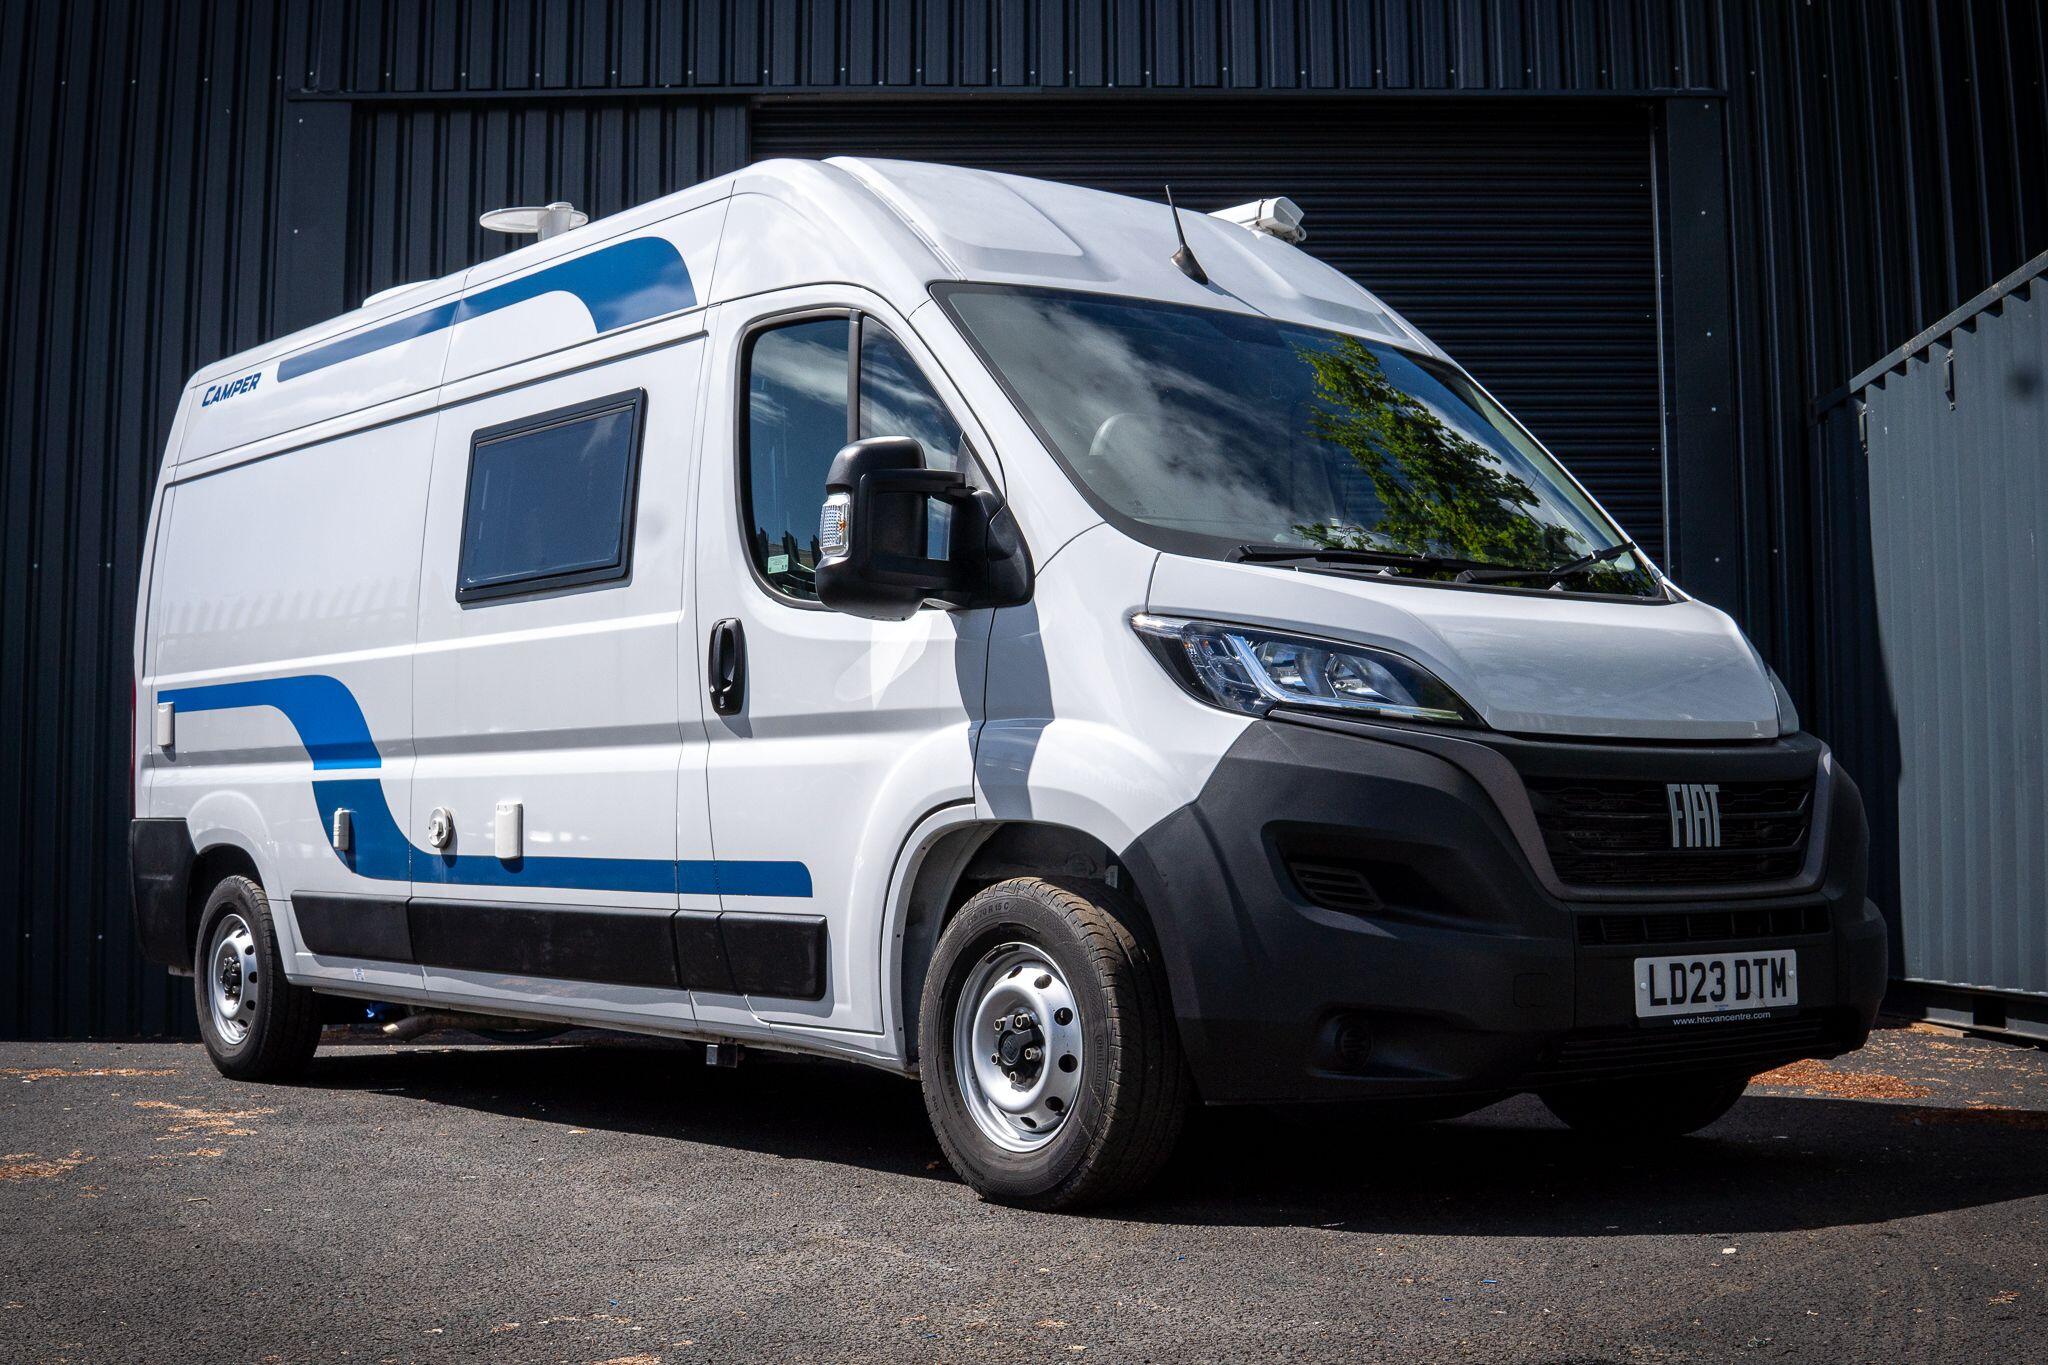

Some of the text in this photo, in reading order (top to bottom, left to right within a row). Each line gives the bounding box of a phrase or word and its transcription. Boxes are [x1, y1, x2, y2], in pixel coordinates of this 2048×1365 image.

[1667, 784, 1721, 848] FIAT
[1648, 957, 1788, 1007] LD23 DTM
[1672, 1011, 1772, 1026] www.htcvancentre.com
